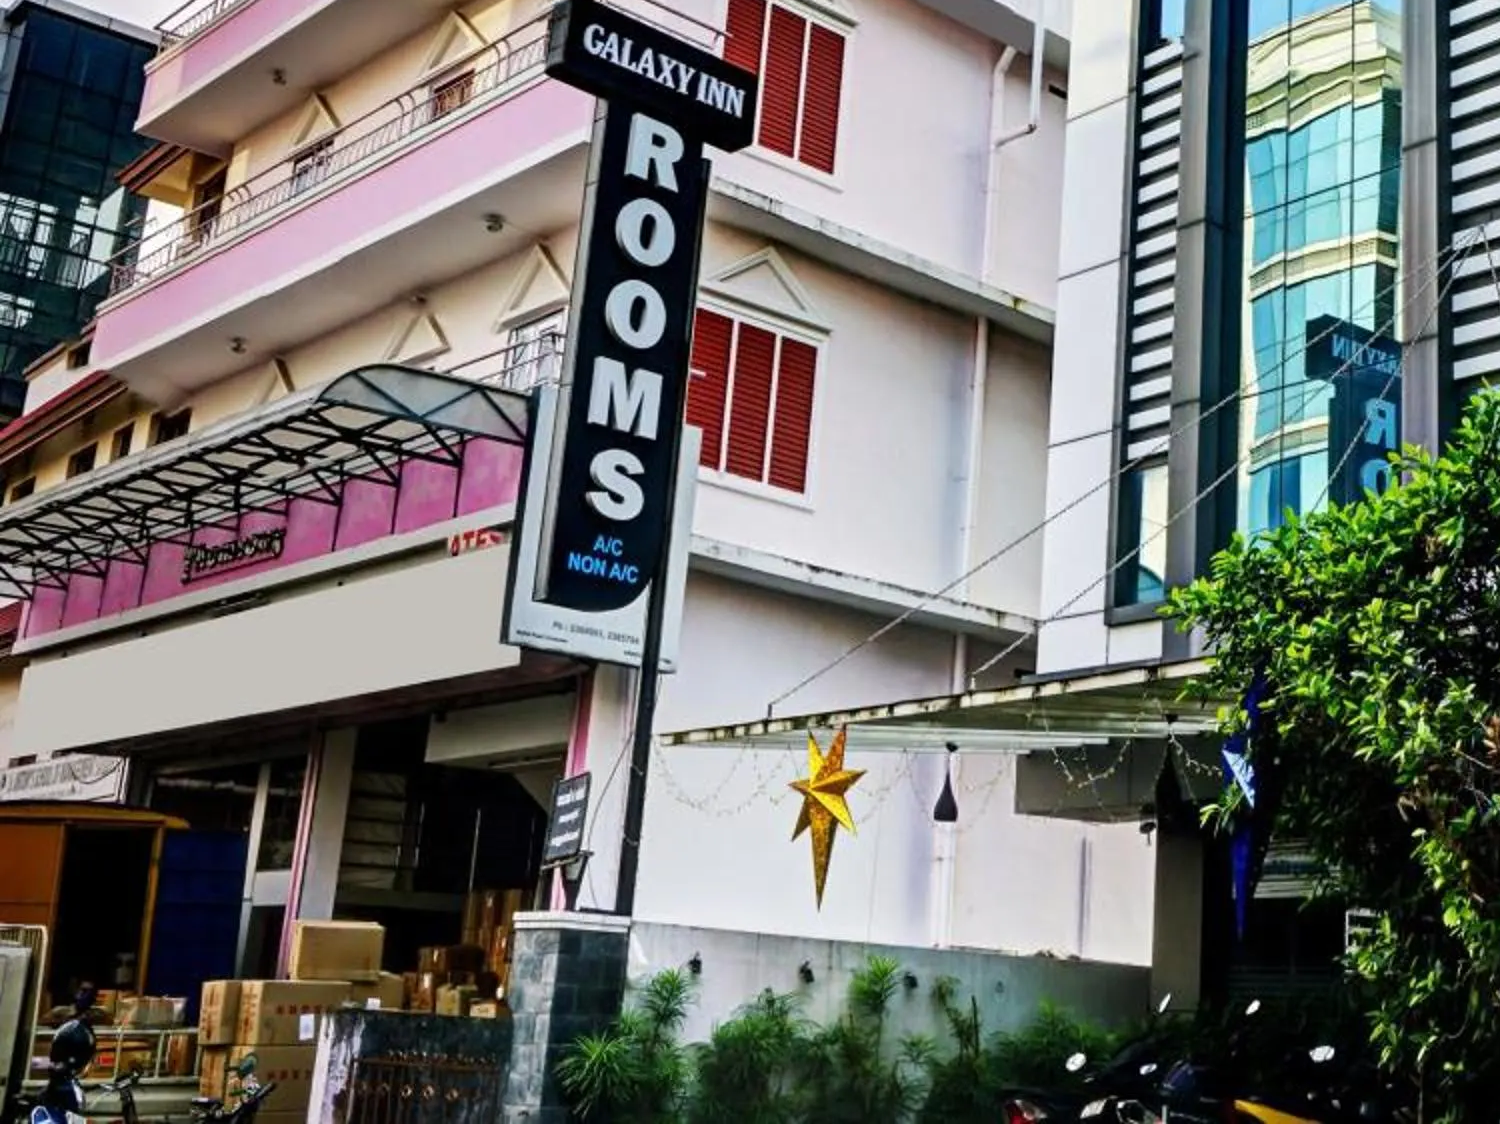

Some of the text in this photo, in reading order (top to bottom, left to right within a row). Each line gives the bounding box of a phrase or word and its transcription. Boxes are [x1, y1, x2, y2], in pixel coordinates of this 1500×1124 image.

[583, 23, 747, 119] GALAXY INN
[585, 112, 685, 522] ROOMS
[567, 552, 640, 584] NON A/C
[593, 535, 625, 557] A/C
